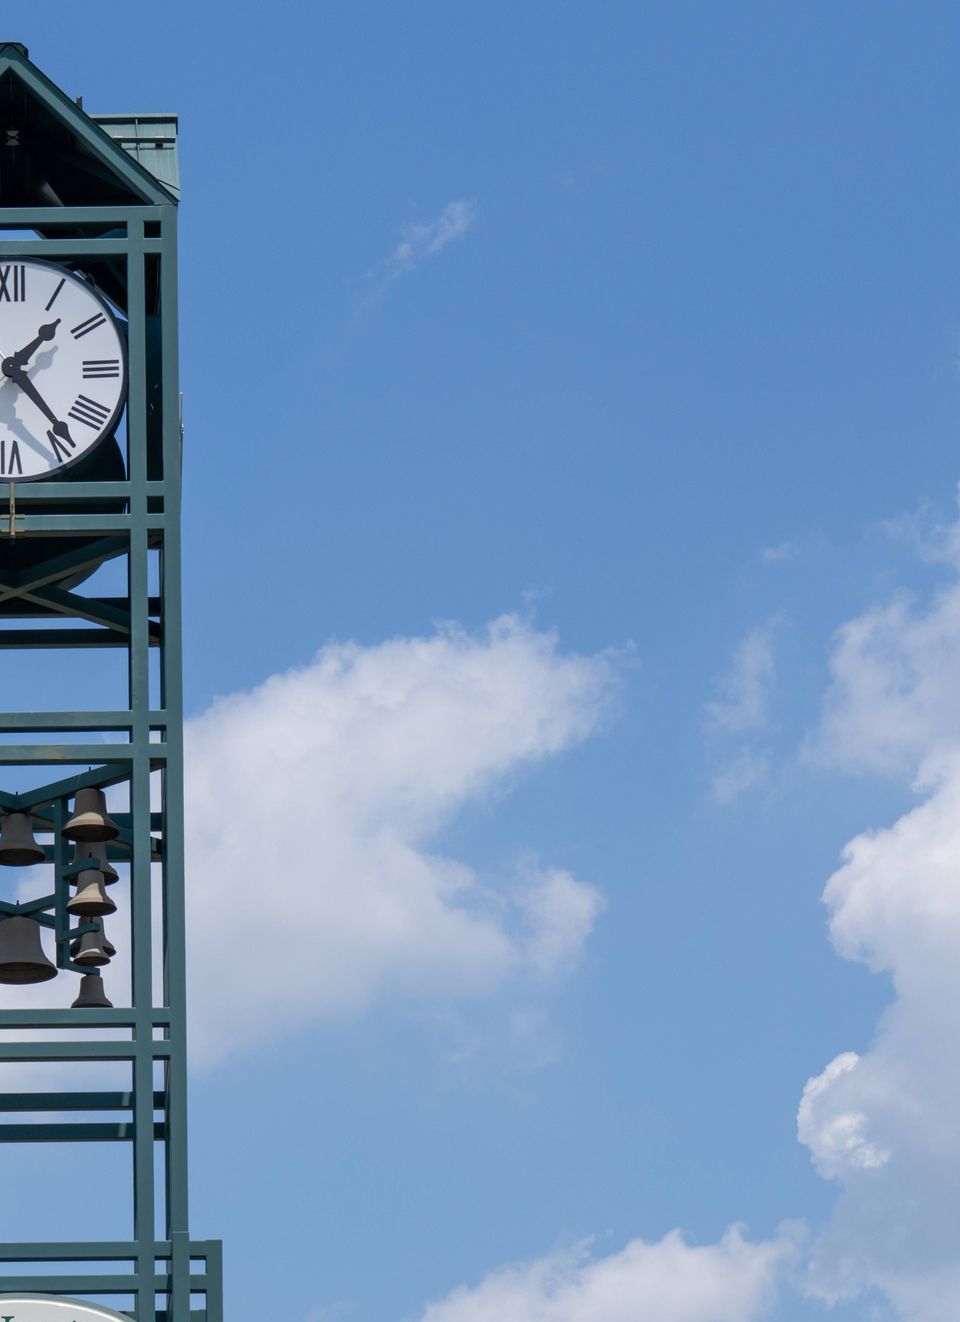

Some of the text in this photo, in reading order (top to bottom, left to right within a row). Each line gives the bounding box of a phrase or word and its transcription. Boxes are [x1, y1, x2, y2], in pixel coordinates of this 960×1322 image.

[45, 278, 66, 311] I
[70, 312, 107, 340] II
[82, 359, 119, 379] III
[67, 393, 111, 431] IIII
[0, 440, 23, 475] VI
[46, 429, 72, 463] V
